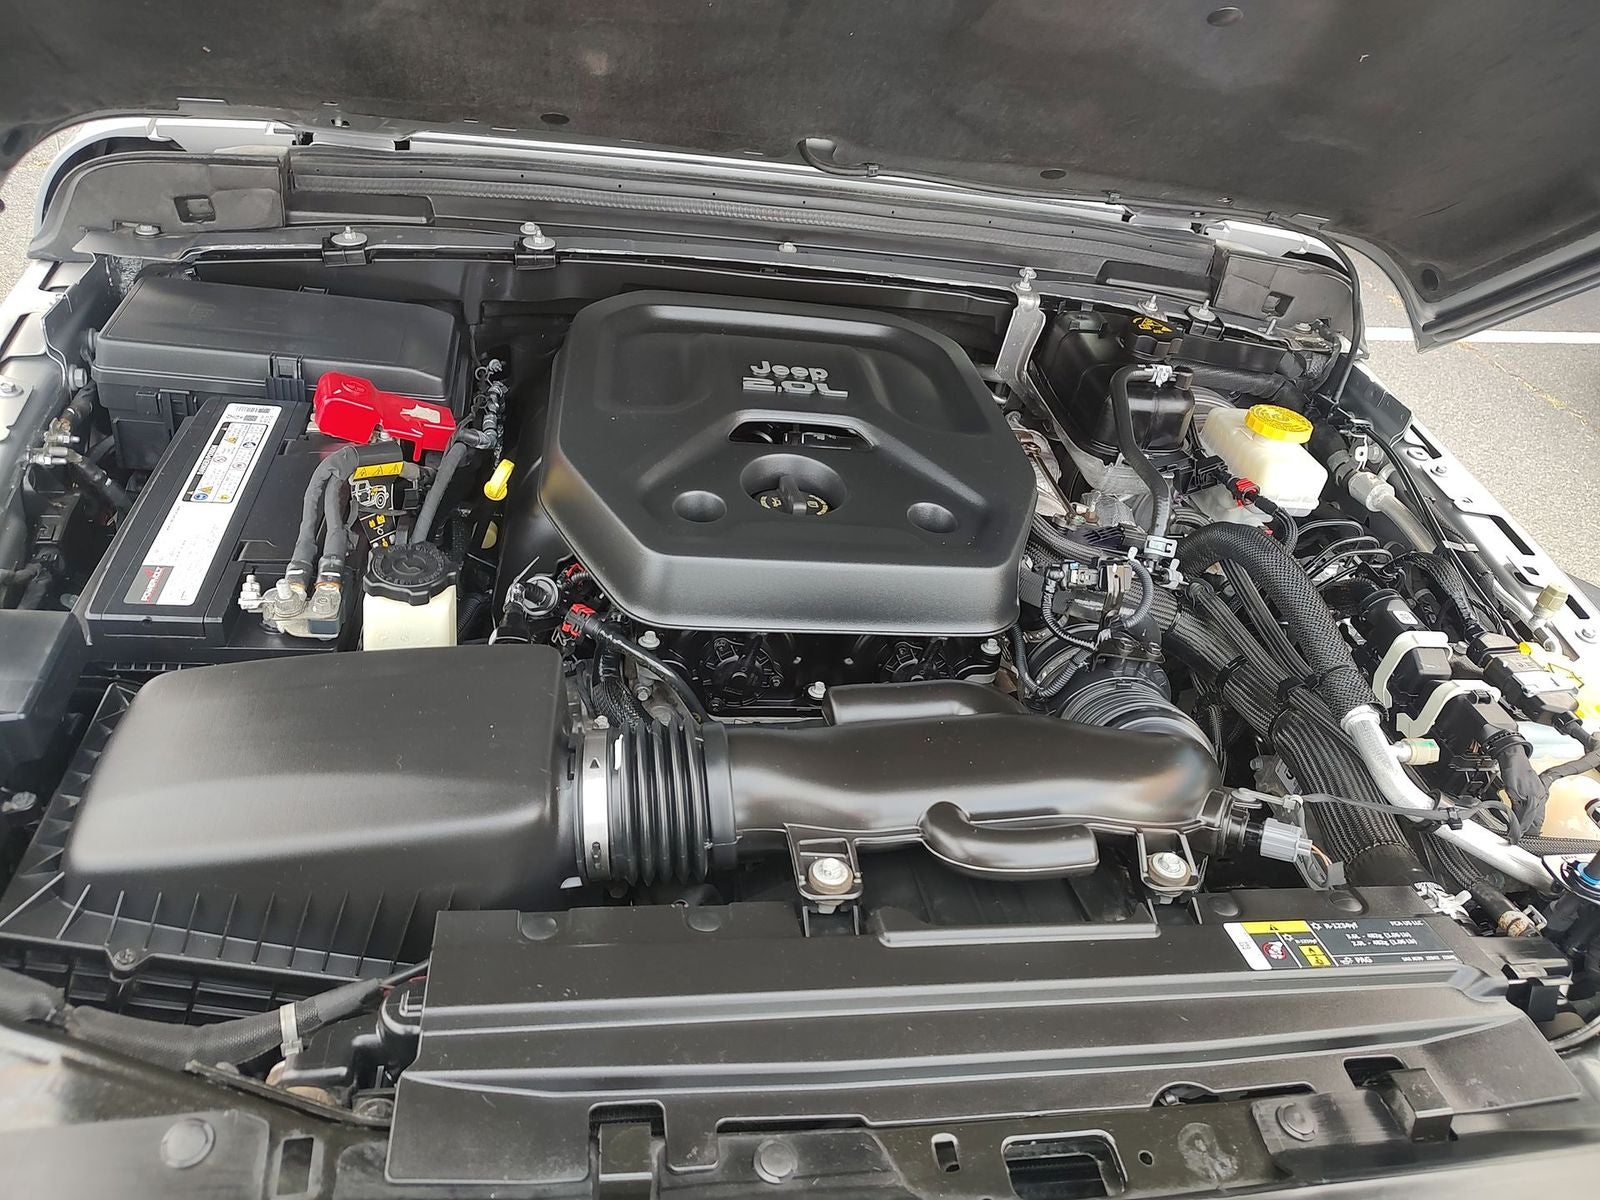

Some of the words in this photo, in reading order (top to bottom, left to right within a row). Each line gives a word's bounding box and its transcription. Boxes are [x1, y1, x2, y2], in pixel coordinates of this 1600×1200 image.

[750, 360, 829, 383] Jeep
[742, 376, 849, 399] 2.0L
[1354, 956, 1374, 964] PAG
